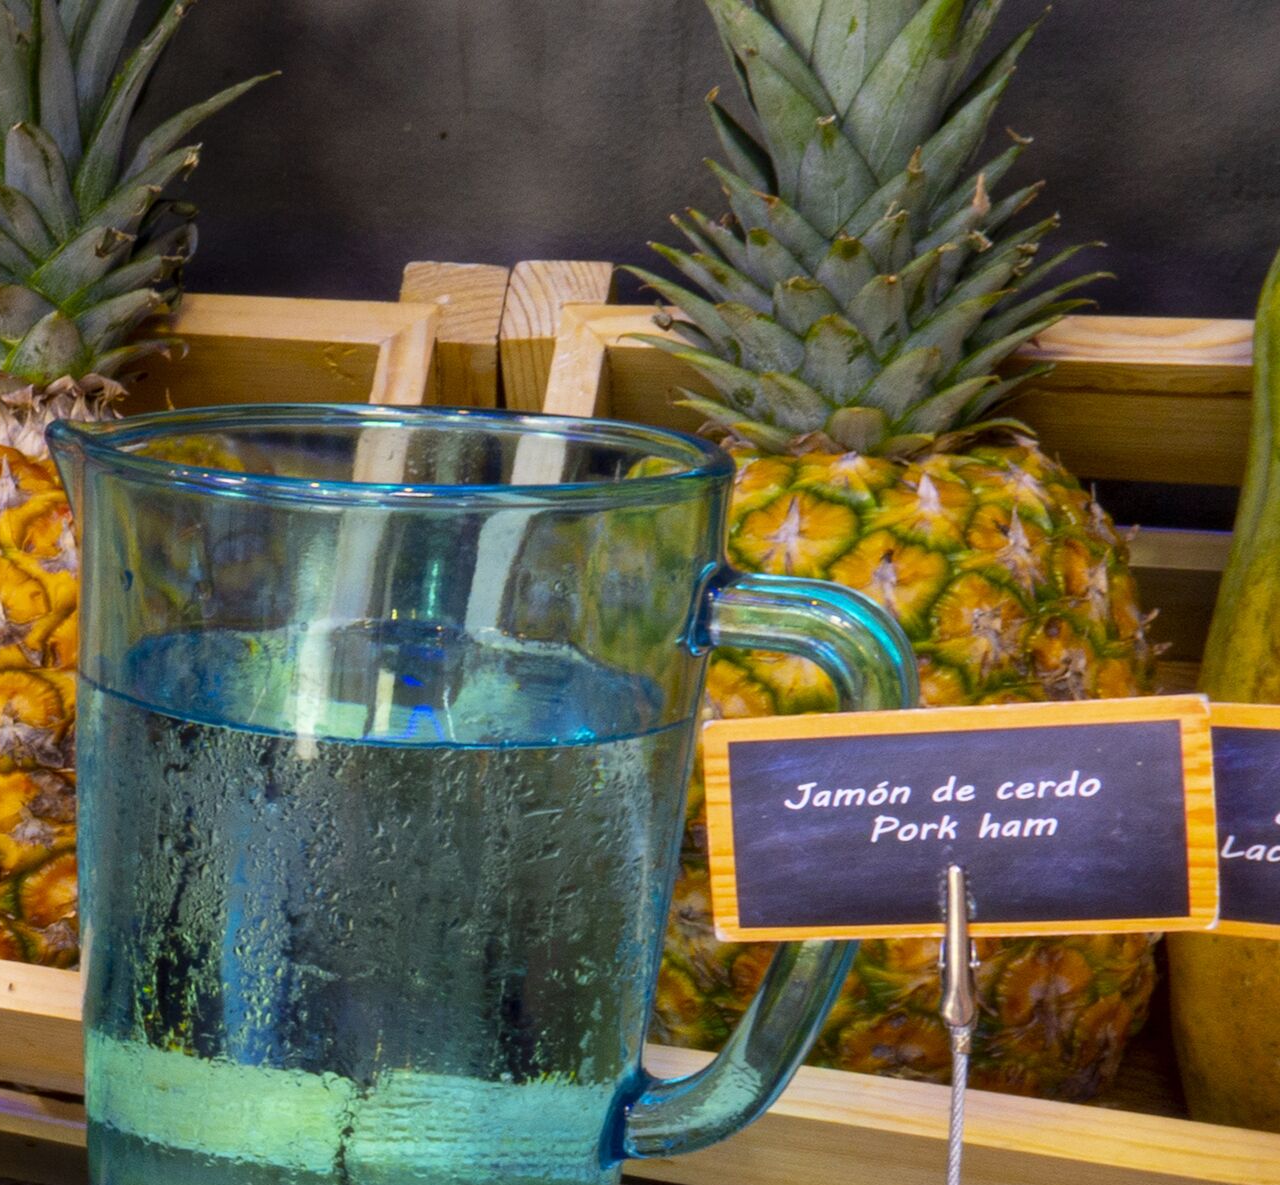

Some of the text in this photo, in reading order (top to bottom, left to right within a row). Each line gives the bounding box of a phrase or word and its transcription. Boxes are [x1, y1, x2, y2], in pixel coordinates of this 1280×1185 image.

[783, 769, 1102, 811] Jamón de cerdo
[870, 812, 1059, 844] Pork ham
